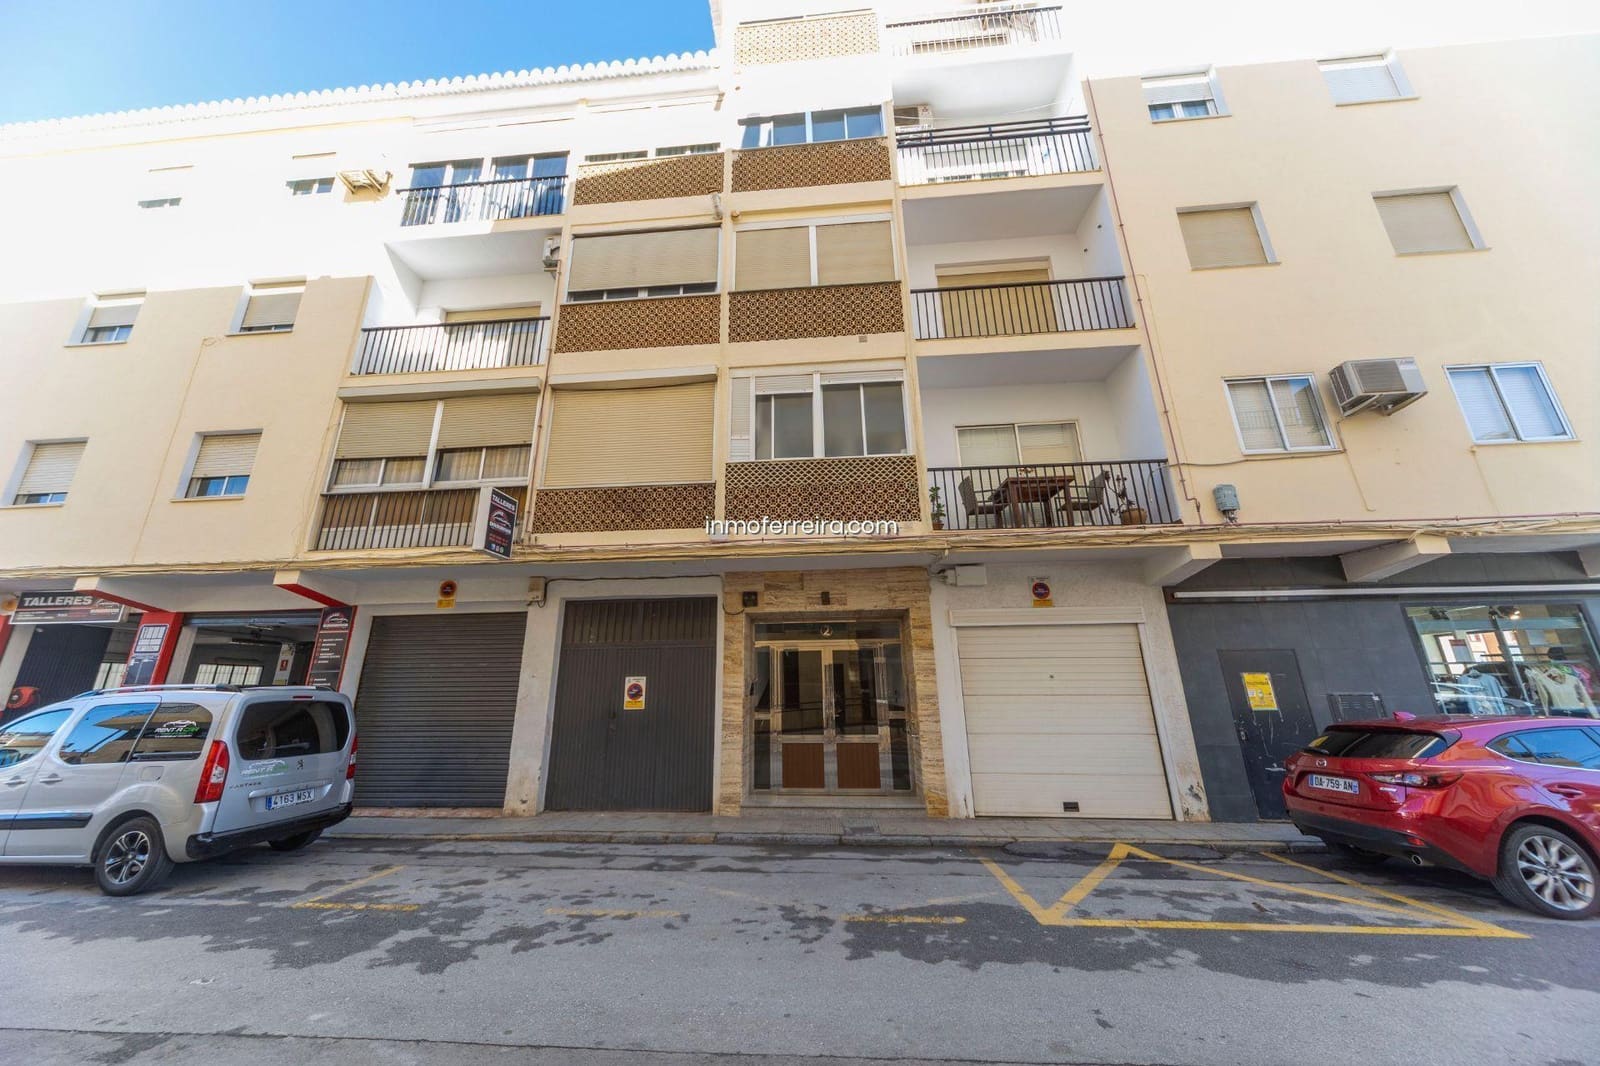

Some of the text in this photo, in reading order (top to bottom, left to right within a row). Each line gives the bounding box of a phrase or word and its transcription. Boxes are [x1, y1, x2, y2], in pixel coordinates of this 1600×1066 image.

[492, 494, 515, 510] TALLERES
[24, 596, 92, 606] TALLERES
[273, 794, 295, 806] 4163
